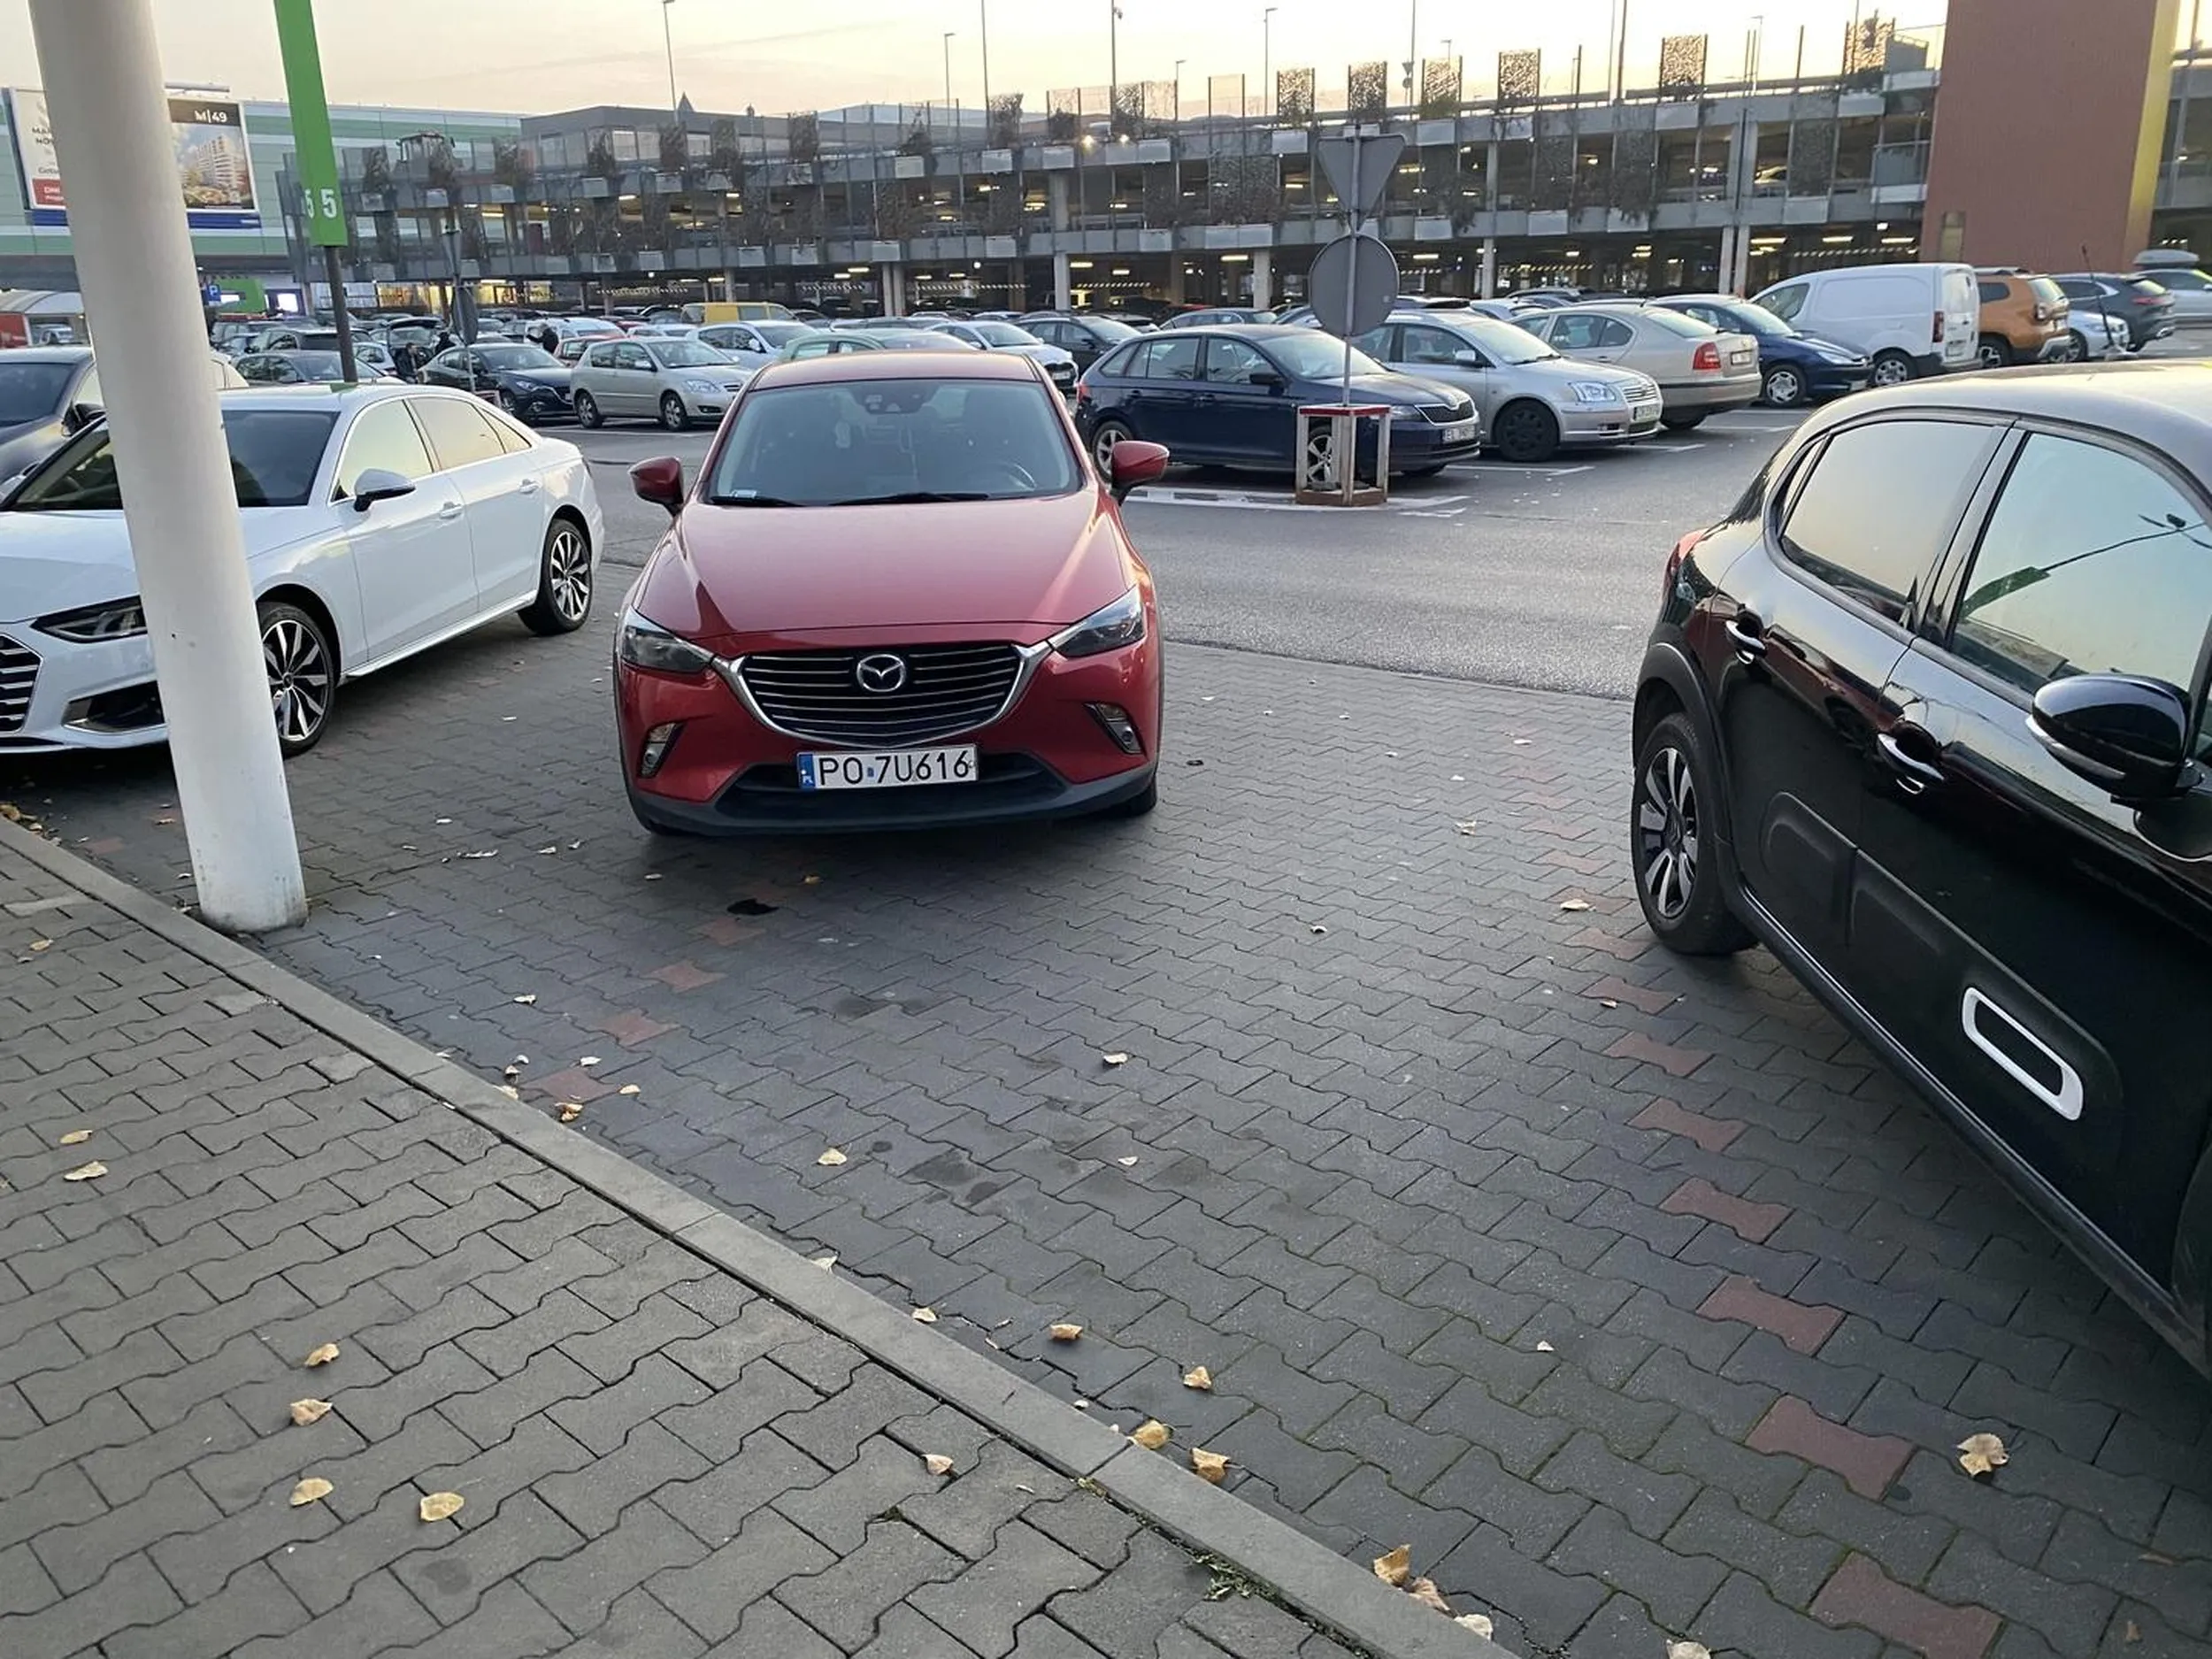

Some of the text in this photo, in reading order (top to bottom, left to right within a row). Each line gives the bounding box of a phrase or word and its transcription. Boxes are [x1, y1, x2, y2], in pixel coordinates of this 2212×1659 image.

[320, 188, 337, 219] 5
[818, 750, 970, 786] PO 7U616
